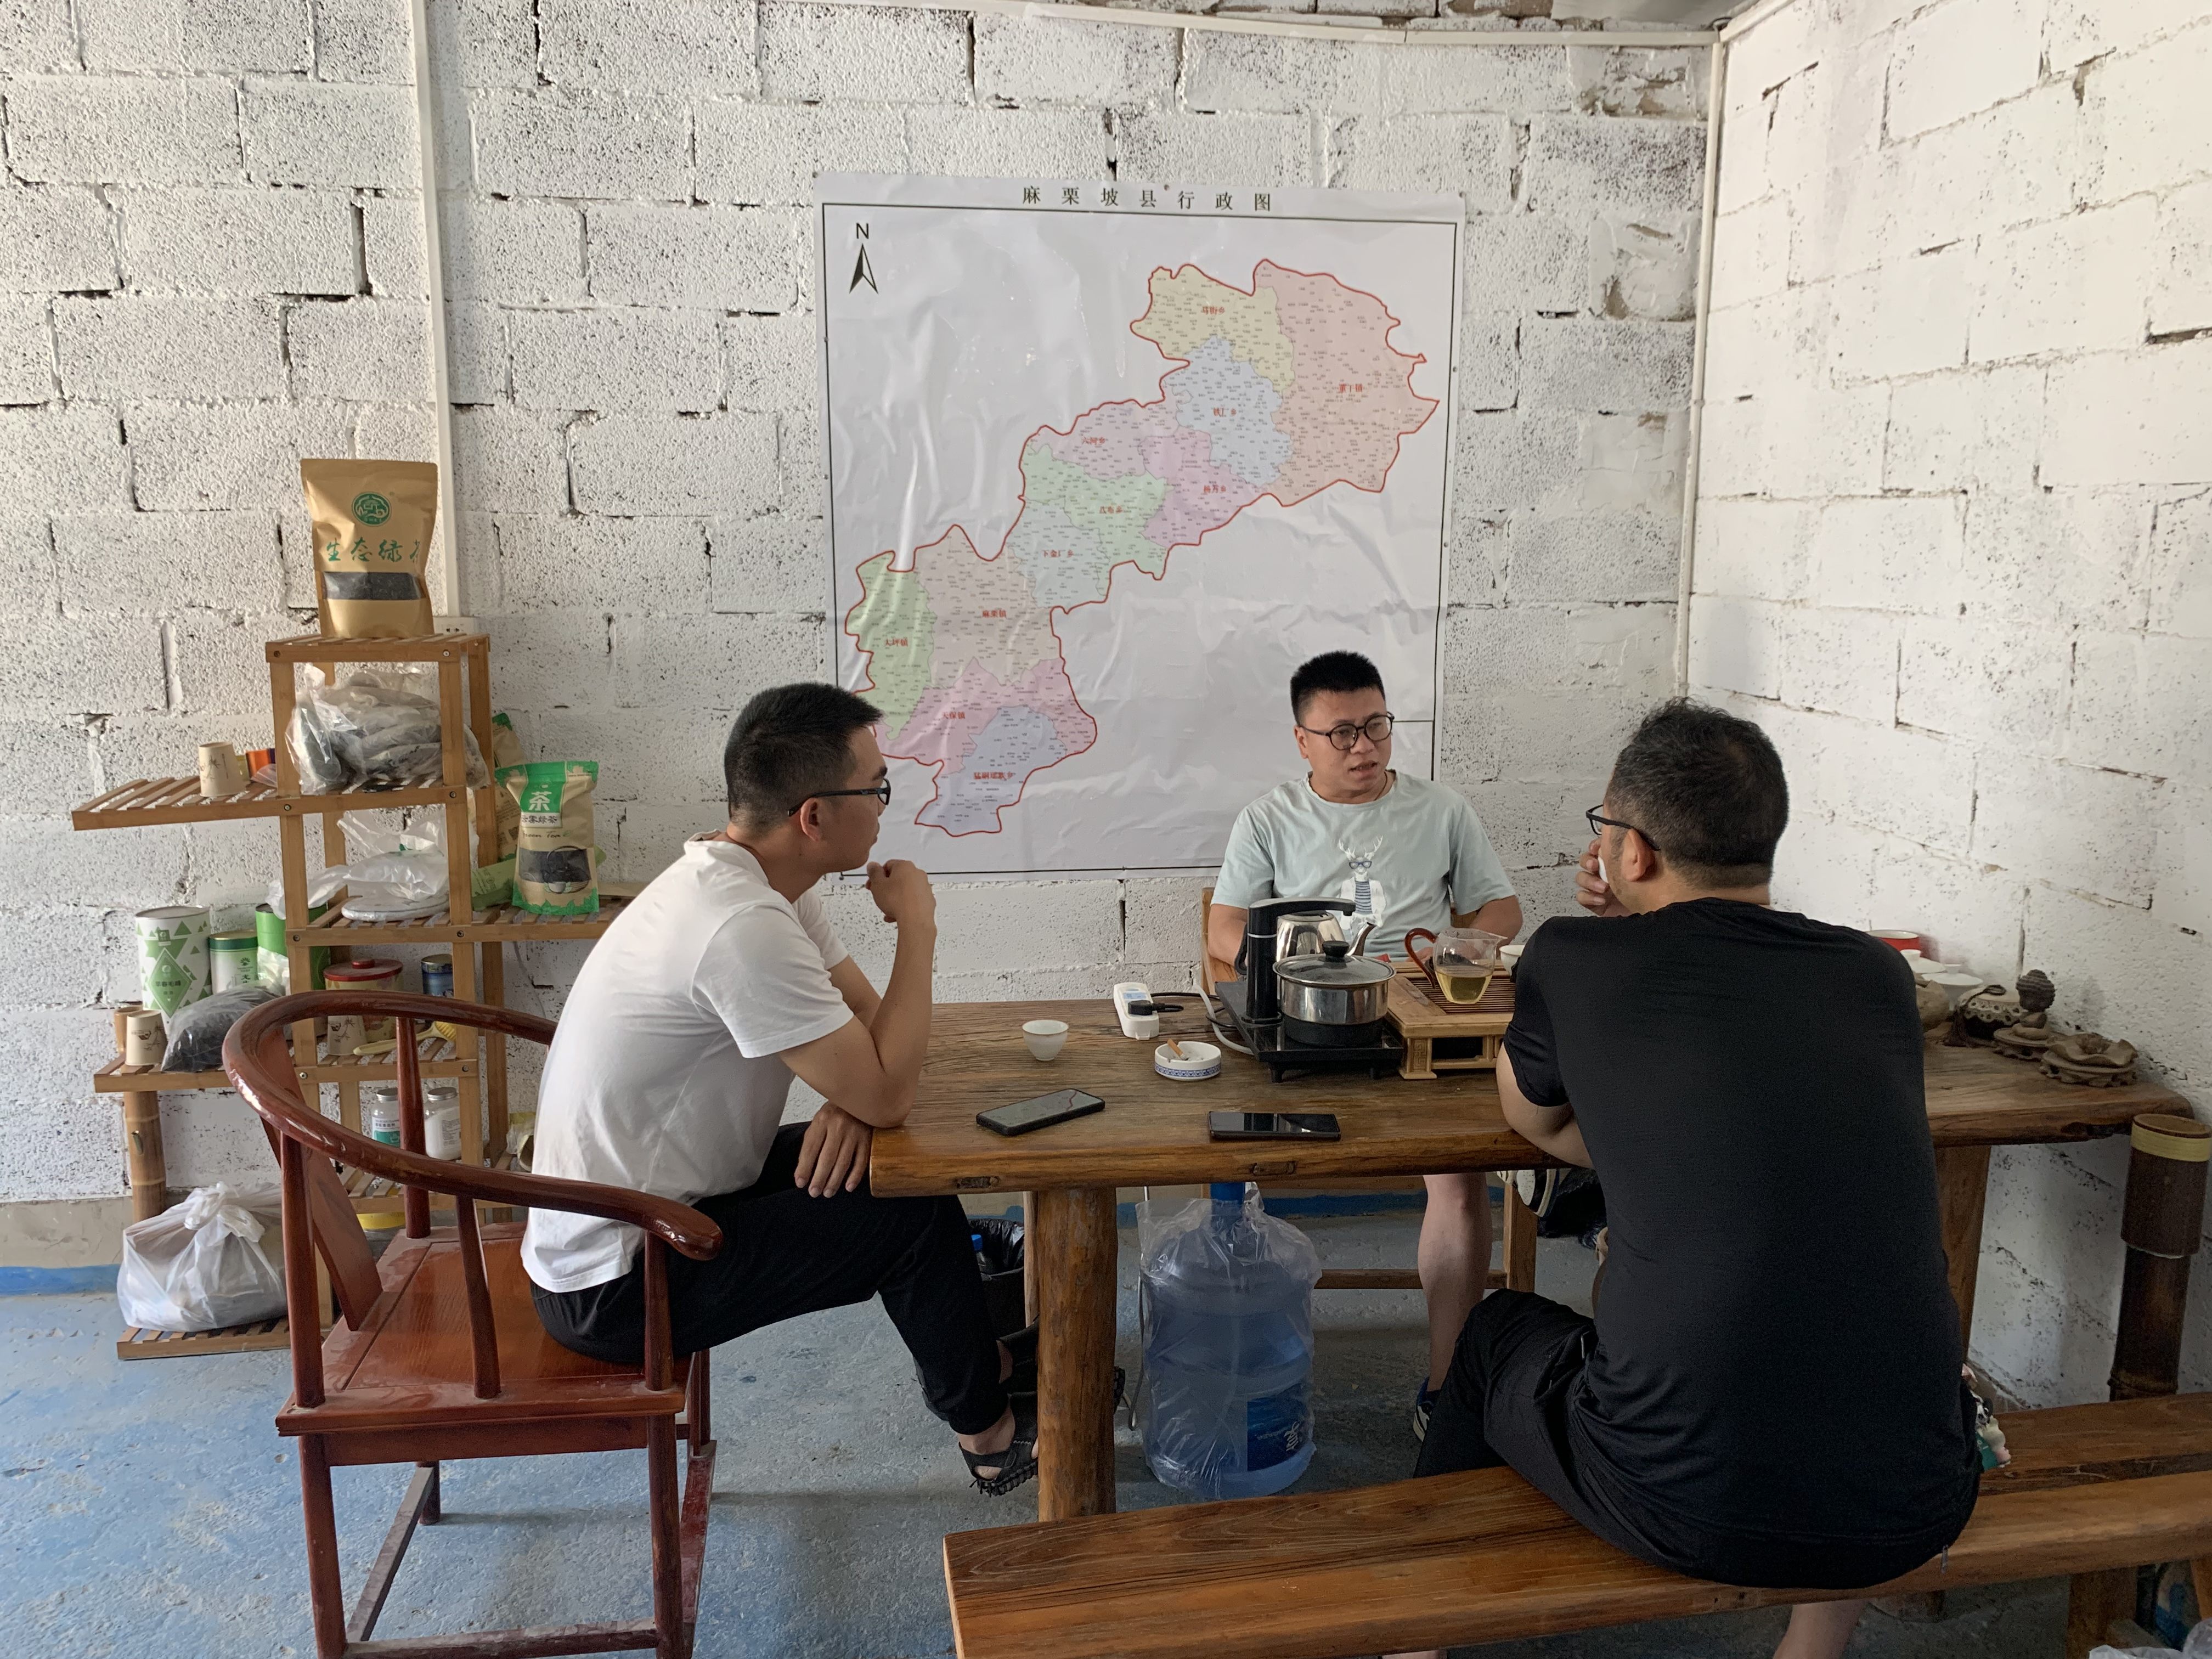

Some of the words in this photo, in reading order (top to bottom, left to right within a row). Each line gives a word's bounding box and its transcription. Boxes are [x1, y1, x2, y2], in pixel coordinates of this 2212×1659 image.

[1022, 185, 1271, 212] 麻栗坡县行政图
[856, 223, 869, 239] N
[528, 791, 552, 811] 茶
